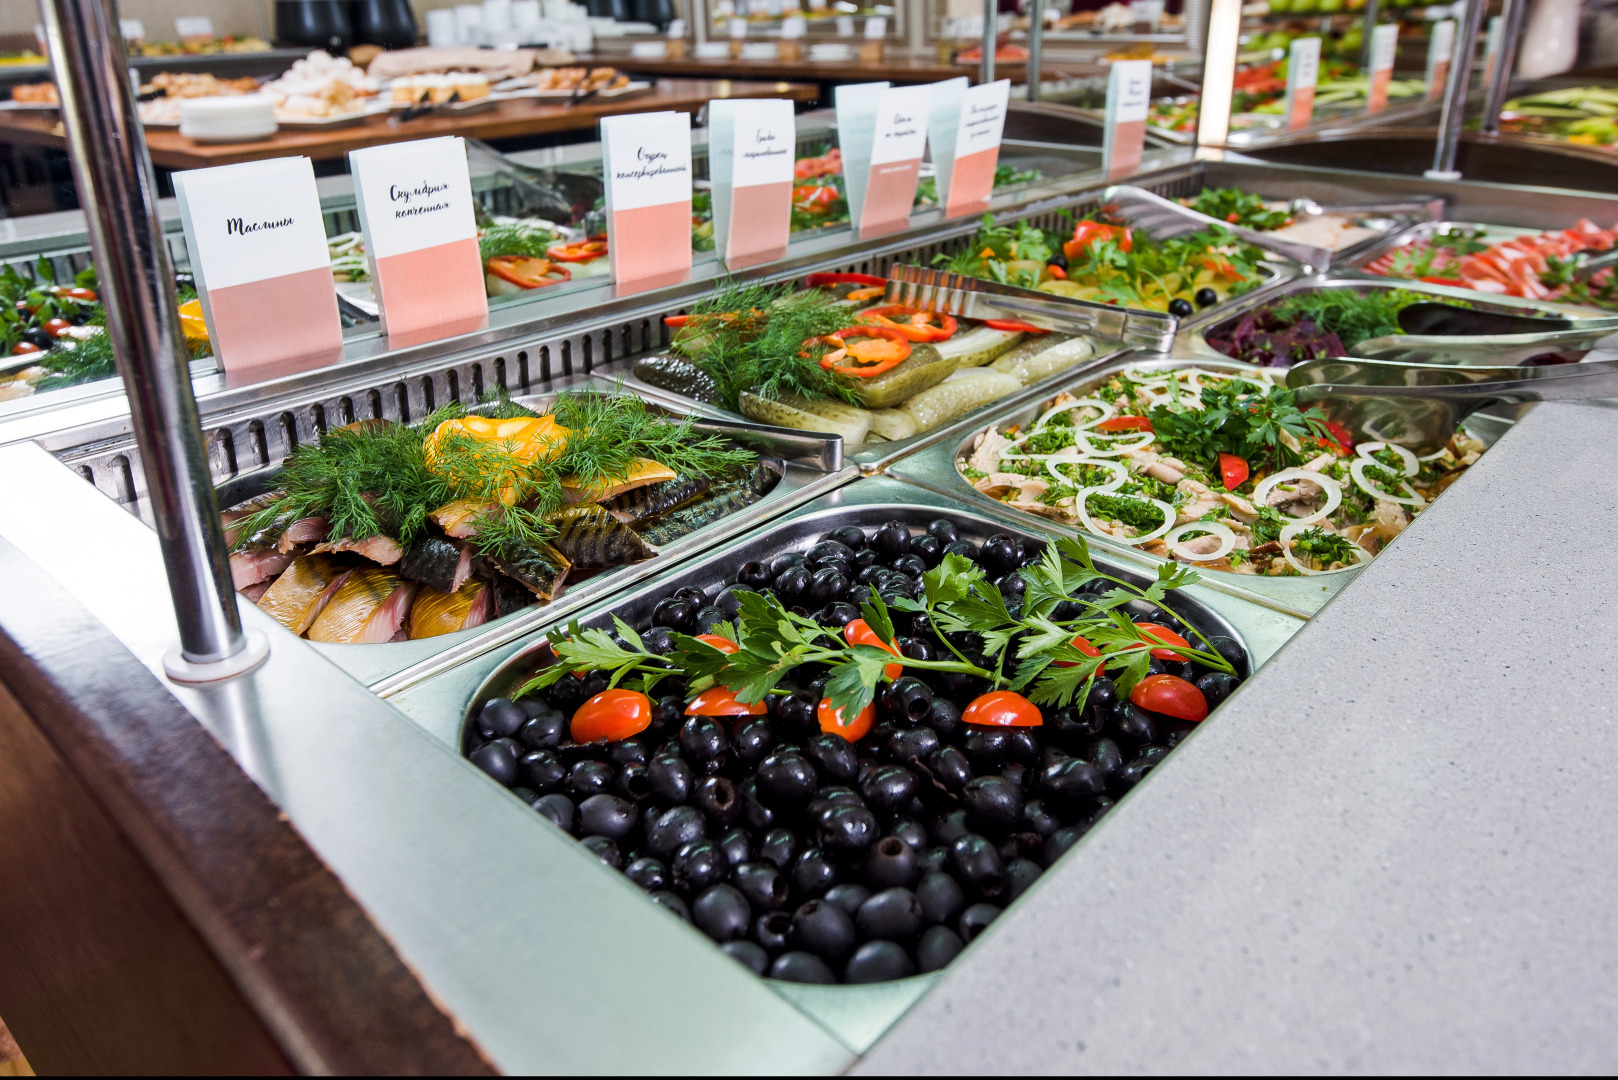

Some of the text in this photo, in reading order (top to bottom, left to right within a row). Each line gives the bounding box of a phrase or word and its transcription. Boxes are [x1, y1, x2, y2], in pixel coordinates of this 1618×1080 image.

[390, 180, 450, 204] Скумбрия
[395, 201, 451, 219] копченная
[226, 216, 295, 236] Маслины
